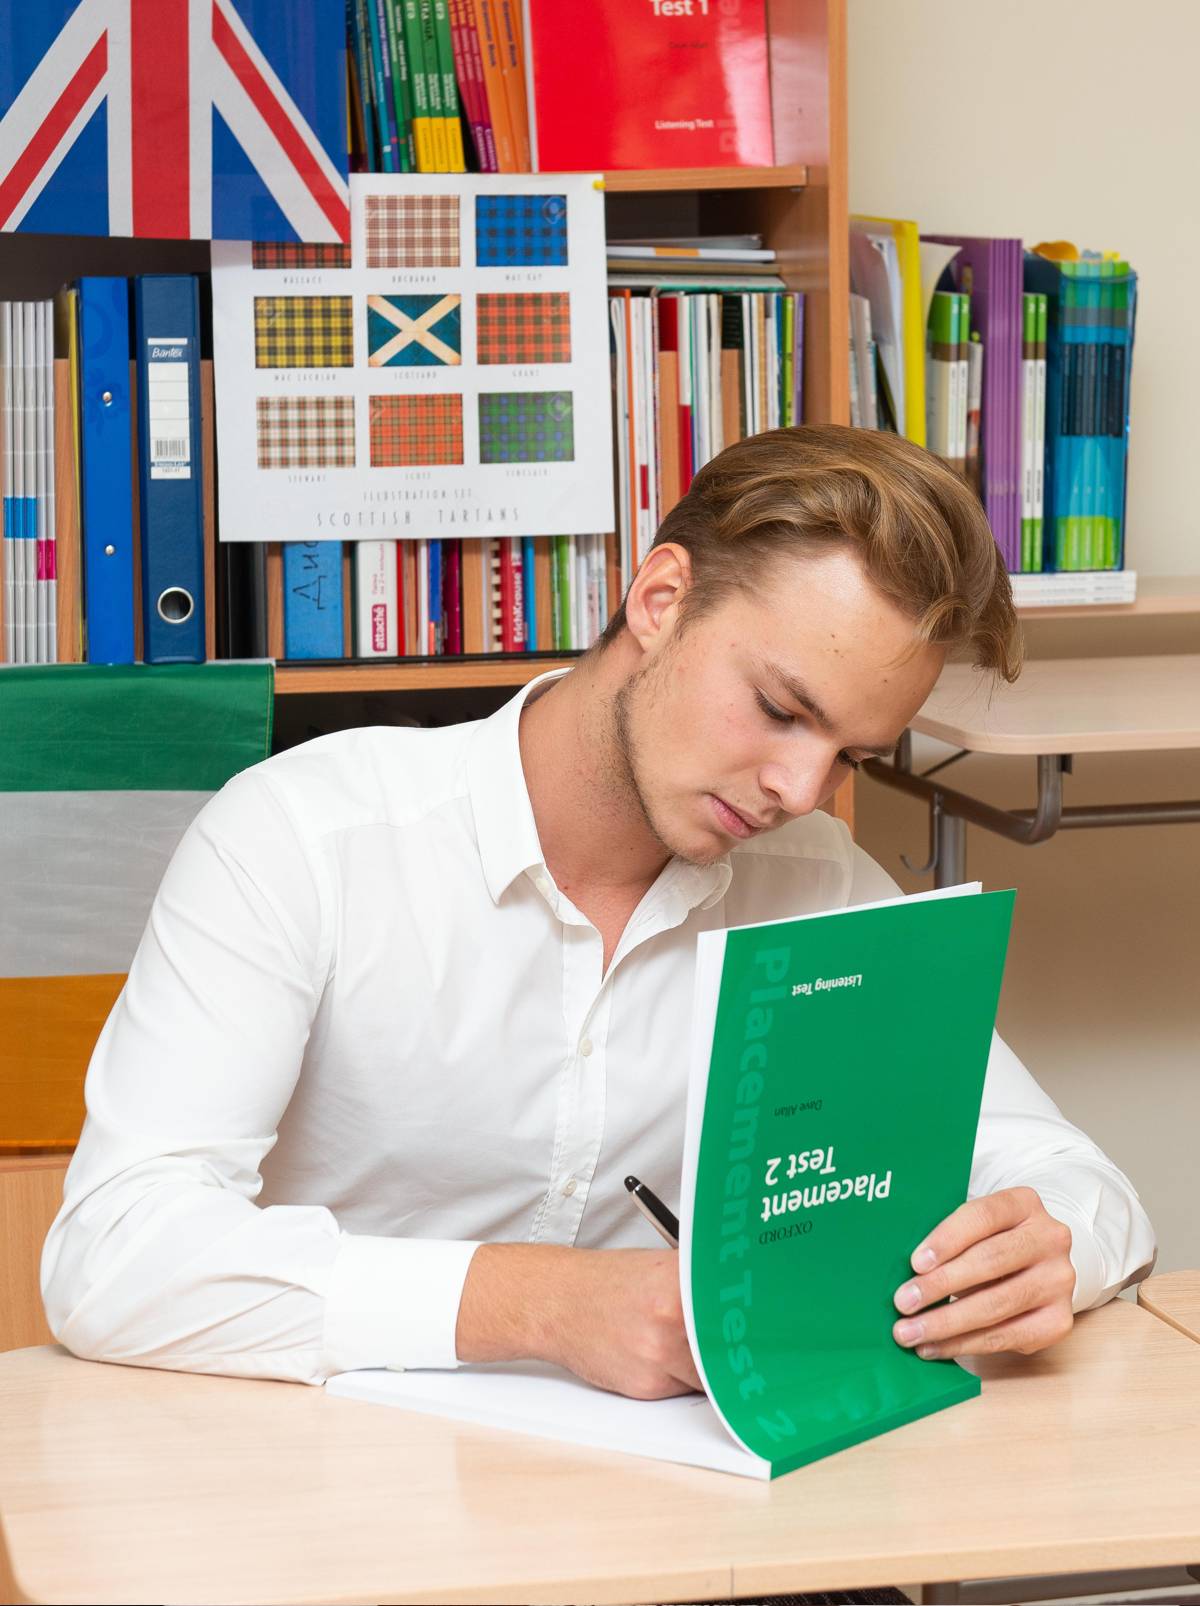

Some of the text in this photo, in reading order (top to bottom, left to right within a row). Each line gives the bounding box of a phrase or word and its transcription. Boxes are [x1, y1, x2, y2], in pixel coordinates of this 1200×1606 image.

[649, 0, 708, 16] Test 1
[655, 118, 714, 131] Listening Test
[152, 347, 183, 358] Bantex
[363, 487, 473, 502] ILLUSTRATION SET
[316, 507, 518, 526] SCOTTISH TARTANS
[512, 572, 523, 643] ErichKrause
[373, 606, 385, 649] attaché
[791, 974, 863, 996] Listening Test
[719, 946, 791, 1264] Placement
[774, 1099, 823, 1117] Dave Allan
[764, 1145, 836, 1186] Test 2
[760, 1170, 892, 1222] Placement
[759, 1220, 813, 1245] OXFORD
[719, 1270, 767, 1401] Test
